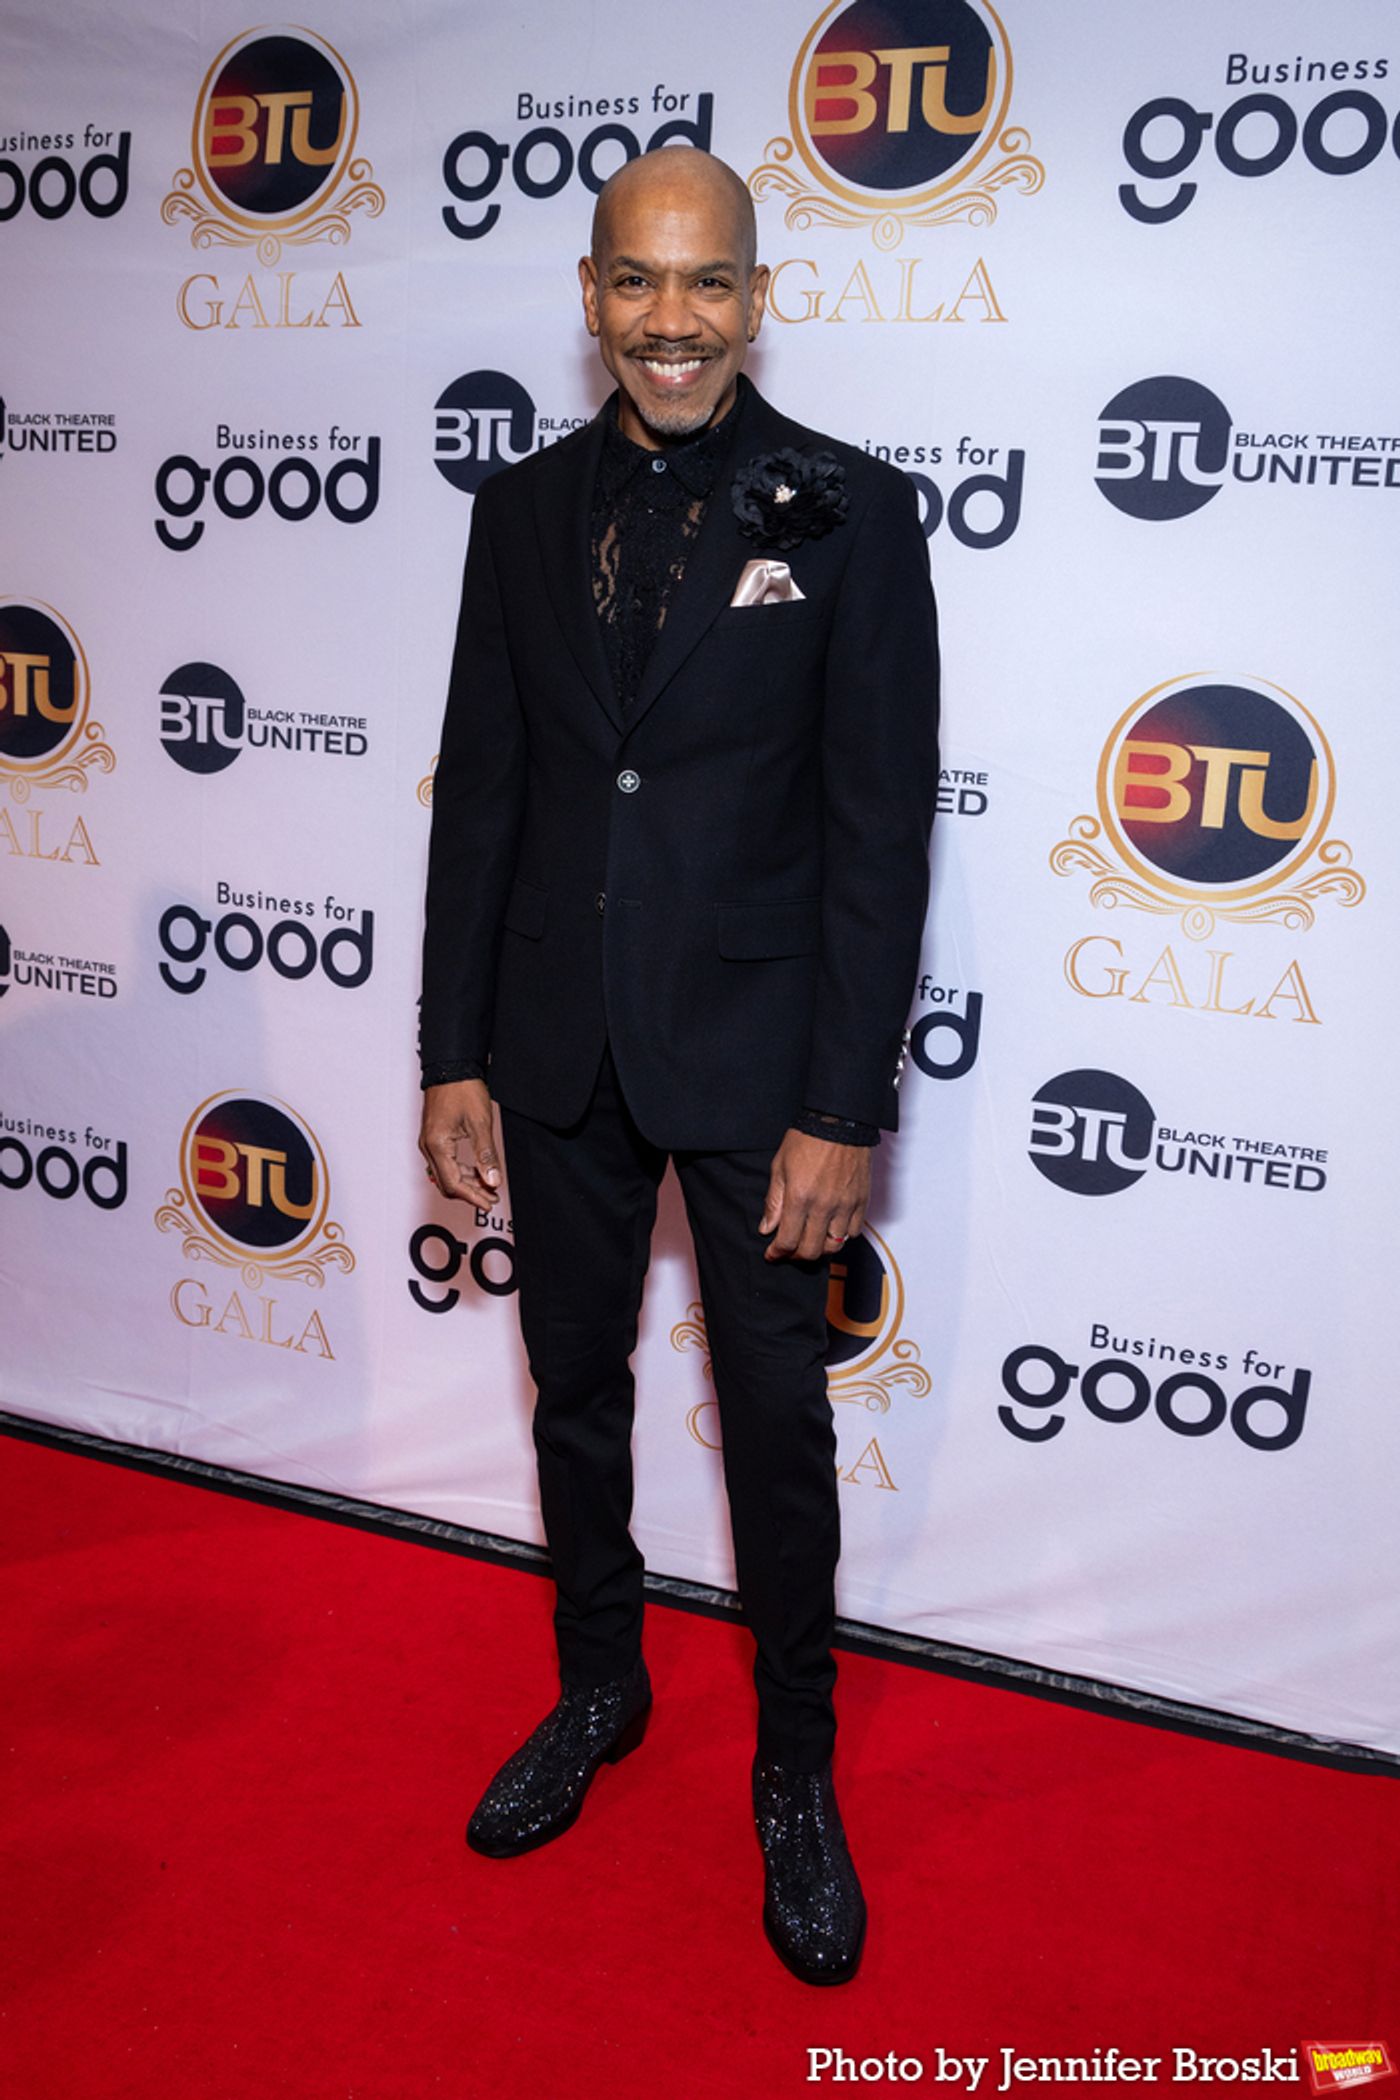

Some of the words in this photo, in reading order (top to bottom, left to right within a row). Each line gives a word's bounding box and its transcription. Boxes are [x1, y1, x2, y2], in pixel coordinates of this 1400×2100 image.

[805, 46, 996, 136] BTU
[1226, 53, 1388, 85] Business
[206, 90, 346, 168] BTU
[517, 92, 639, 120] Business
[652, 84, 690, 113] for
[0, 131, 75, 153] usiness
[84, 123, 113, 148] for
[1118, 89, 1400, 225] goo
[0, 131, 131, 222] ood
[176, 271, 362, 331] GALA
[765, 257, 1008, 324] GALA
[8, 413, 51, 426] BLACK
[54, 413, 116, 427] THEATRE
[8, 428, 117, 453] UNITED
[217, 424, 318, 451] Business
[328, 426, 360, 452] for
[434, 408, 540, 464] BTU
[1235, 433, 1309, 449] BLACK
[957, 436, 999, 466] for
[1094, 419, 1232, 486] BTU
[155, 436, 381, 552] good
[0, 652, 80, 723] TU
[158, 694, 246, 749] BTU
[247, 708, 296, 723] BLACK
[299, 712, 367, 730] THEATRE
[247, 723, 368, 757] UNITED
[1119, 739, 1319, 840] BTU
[0, 807, 100, 867] ALA
[217, 882, 314, 917] Business
[325, 896, 355, 921] for
[14, 949, 54, 966] BLACK
[58, 956, 116, 975] THEATRE
[159, 904, 373, 995] good
[14, 963, 118, 998] UNITED
[919, 974, 959, 1004] for
[1064, 935, 1322, 1025] GALA
[0, 1112, 76, 1145] usiness
[84, 1126, 111, 1150] for
[1028, 1100, 1156, 1172] BTU
[1158, 1128, 1226, 1149] BLACK
[1232, 1138, 1328, 1163] THEATRE
[0, 1136, 127, 1210] ood
[191, 1135, 318, 1221] BTU
[1156, 1144, 1327, 1193] UNITED
[170, 1278, 336, 1361] GALA
[1090, 1324, 1228, 1371] Business
[1243, 1350, 1286, 1380] for
[998, 1344, 1312, 1451] good
